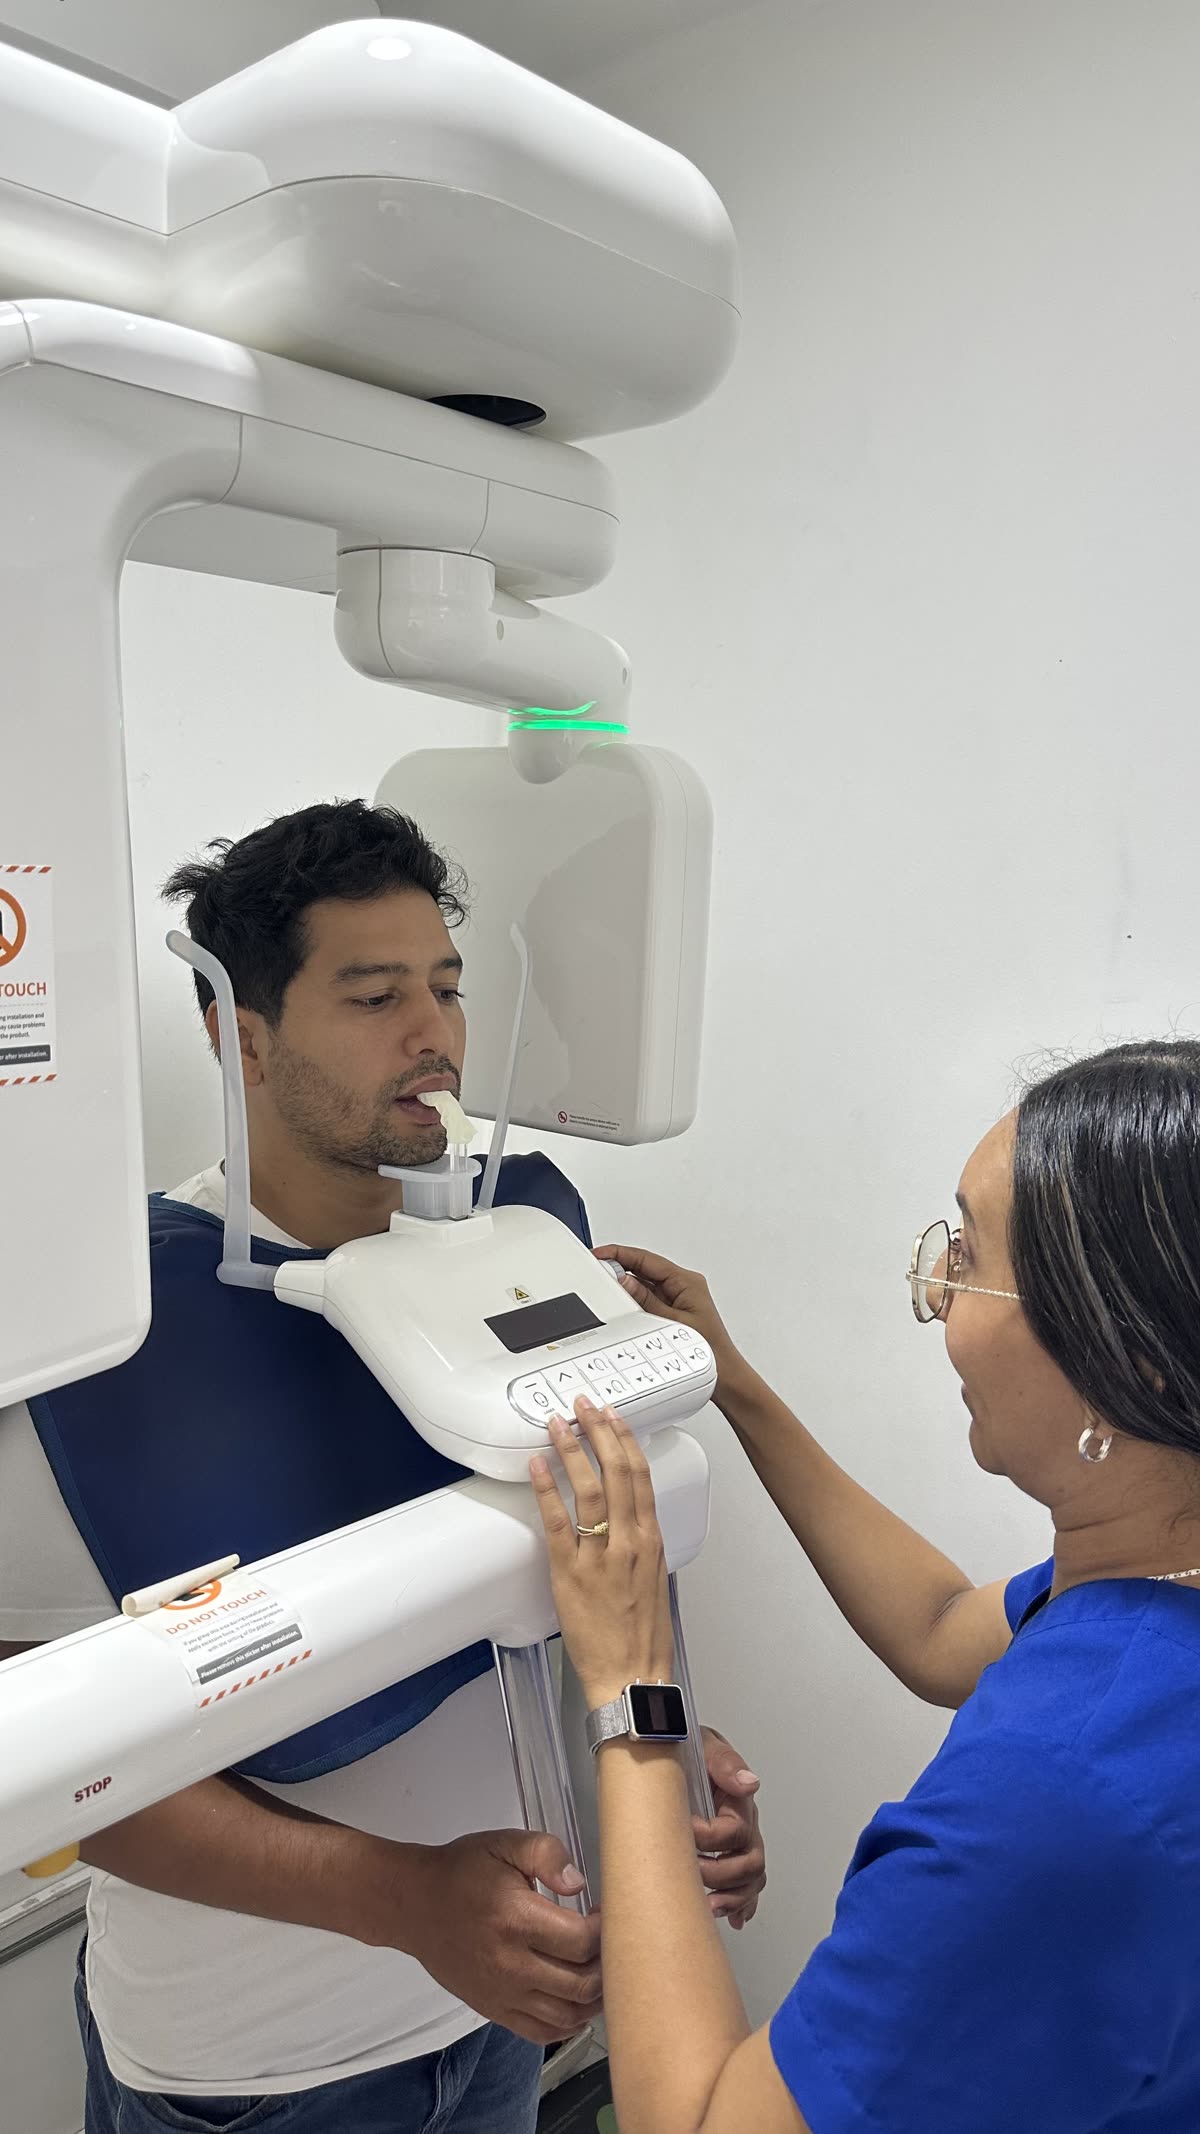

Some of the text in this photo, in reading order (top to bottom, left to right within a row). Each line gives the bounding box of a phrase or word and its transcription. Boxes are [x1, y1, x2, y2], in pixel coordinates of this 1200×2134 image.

[22, 1022, 46, 1030] problems
[166, 1589, 267, 1635] DO NOT TOUCH
[235, 1653, 245, 1664] this
[260, 1642, 272, 1651] after
[75, 1776, 112, 1803] STOP
